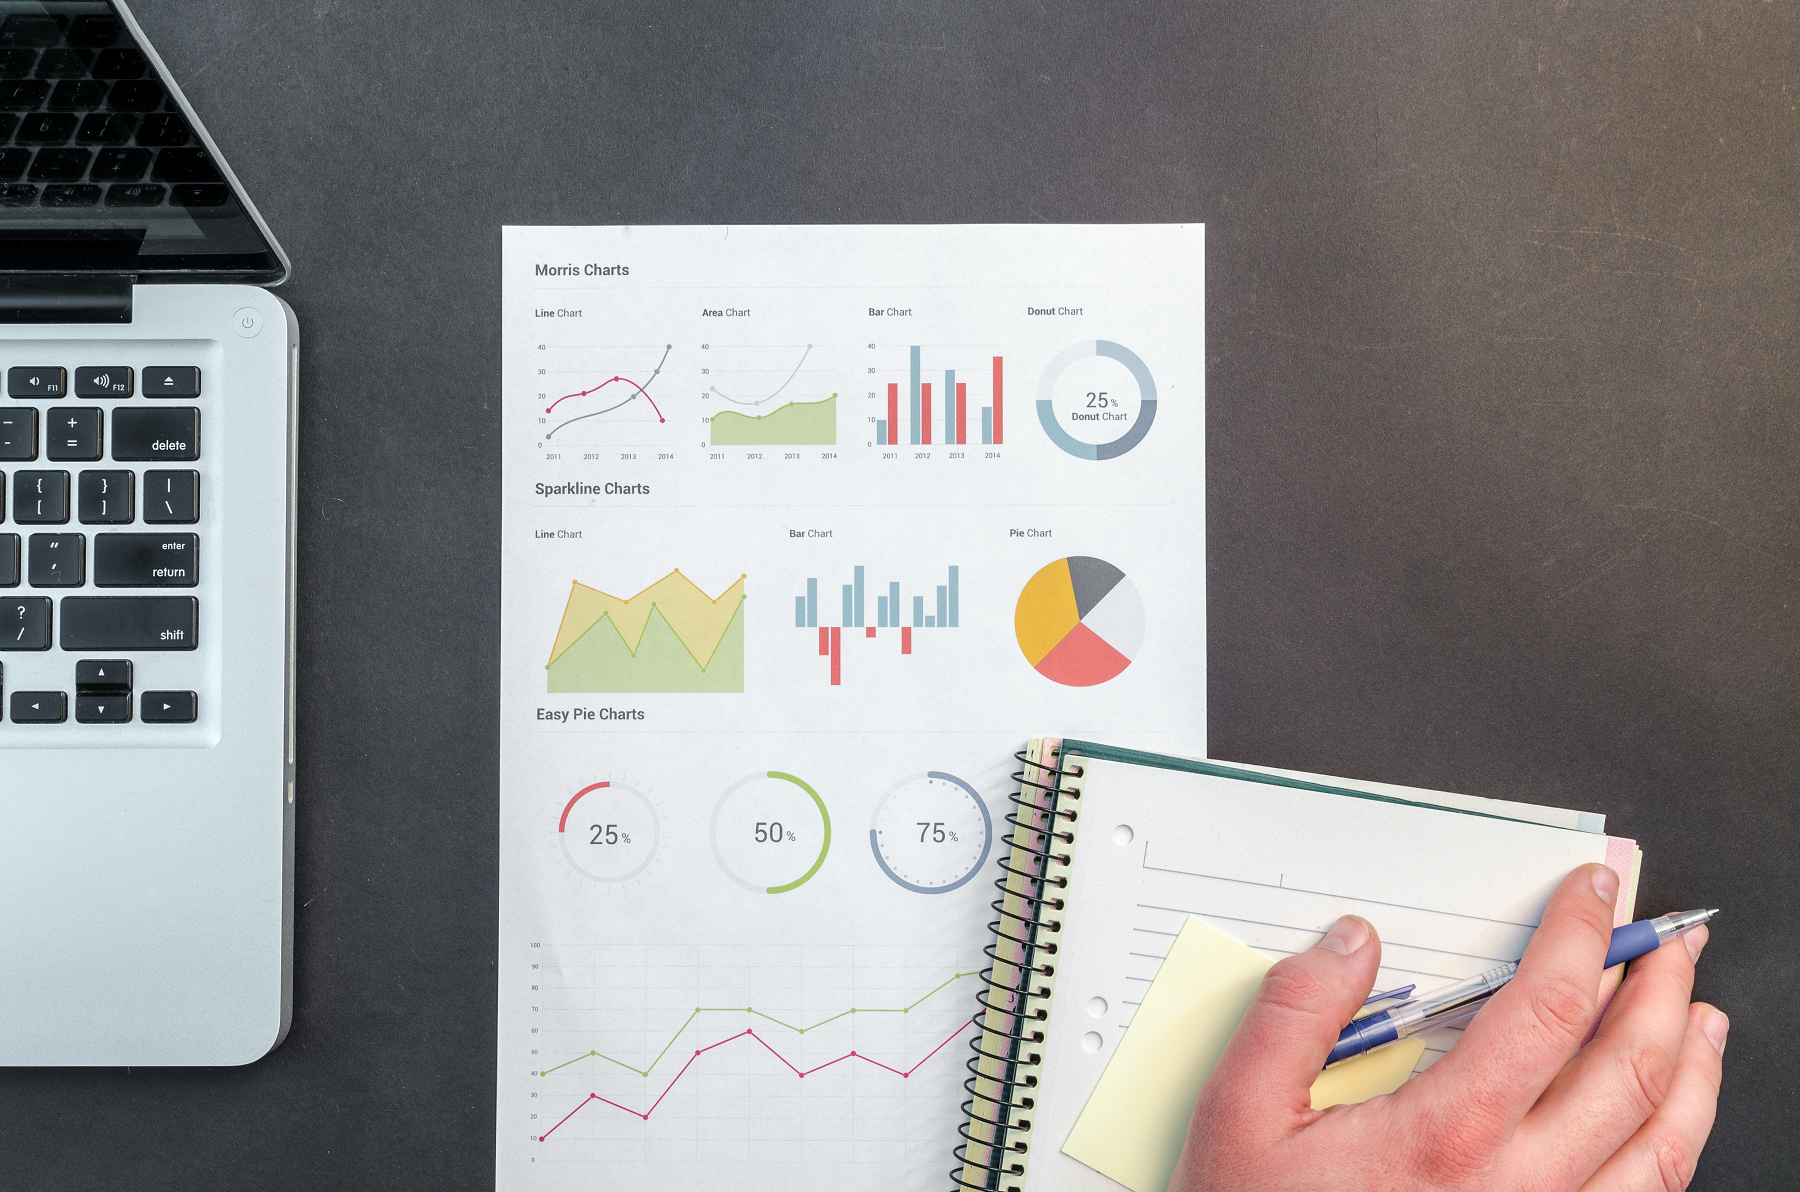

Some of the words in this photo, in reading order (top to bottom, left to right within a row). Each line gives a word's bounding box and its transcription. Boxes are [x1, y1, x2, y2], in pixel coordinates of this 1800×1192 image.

[536, 264, 579, 276] Morris
[585, 263, 629, 275] Charts
[535, 308, 555, 318] Line
[557, 308, 583, 318] Chart
[701, 308, 724, 317] Area
[725, 307, 751, 317] Chart
[868, 307, 885, 317] Bar
[886, 307, 912, 317] Chart
[1027, 306, 1056, 316] Donut
[1057, 306, 1084, 316] Chart
[47, 384, 58, 392] F11
[112, 383, 125, 391] F12
[1071, 412, 1100, 421] Donut
[1102, 411, 1128, 421] Chart
[151, 439, 187, 451] delete
[784, 452, 800, 460] 2013
[821, 452, 838, 460] 2014
[882, 452, 898, 460] 2011
[536, 482, 600, 497] Sparkline
[605, 482, 649, 494] Charts
[535, 529, 555, 539] Line
[557, 529, 583, 539] Chart
[789, 529, 806, 538] Bar
[807, 528, 833, 538] Chart
[1009, 528, 1025, 538] Pie
[1026, 528, 1053, 538] Chart
[161, 541, 186, 550] enter
[152, 567, 186, 577] return
[160, 629, 185, 641] shift
[537, 708, 569, 723] Easy
[574, 708, 594, 720] Pie
[600, 708, 644, 720] Charts
